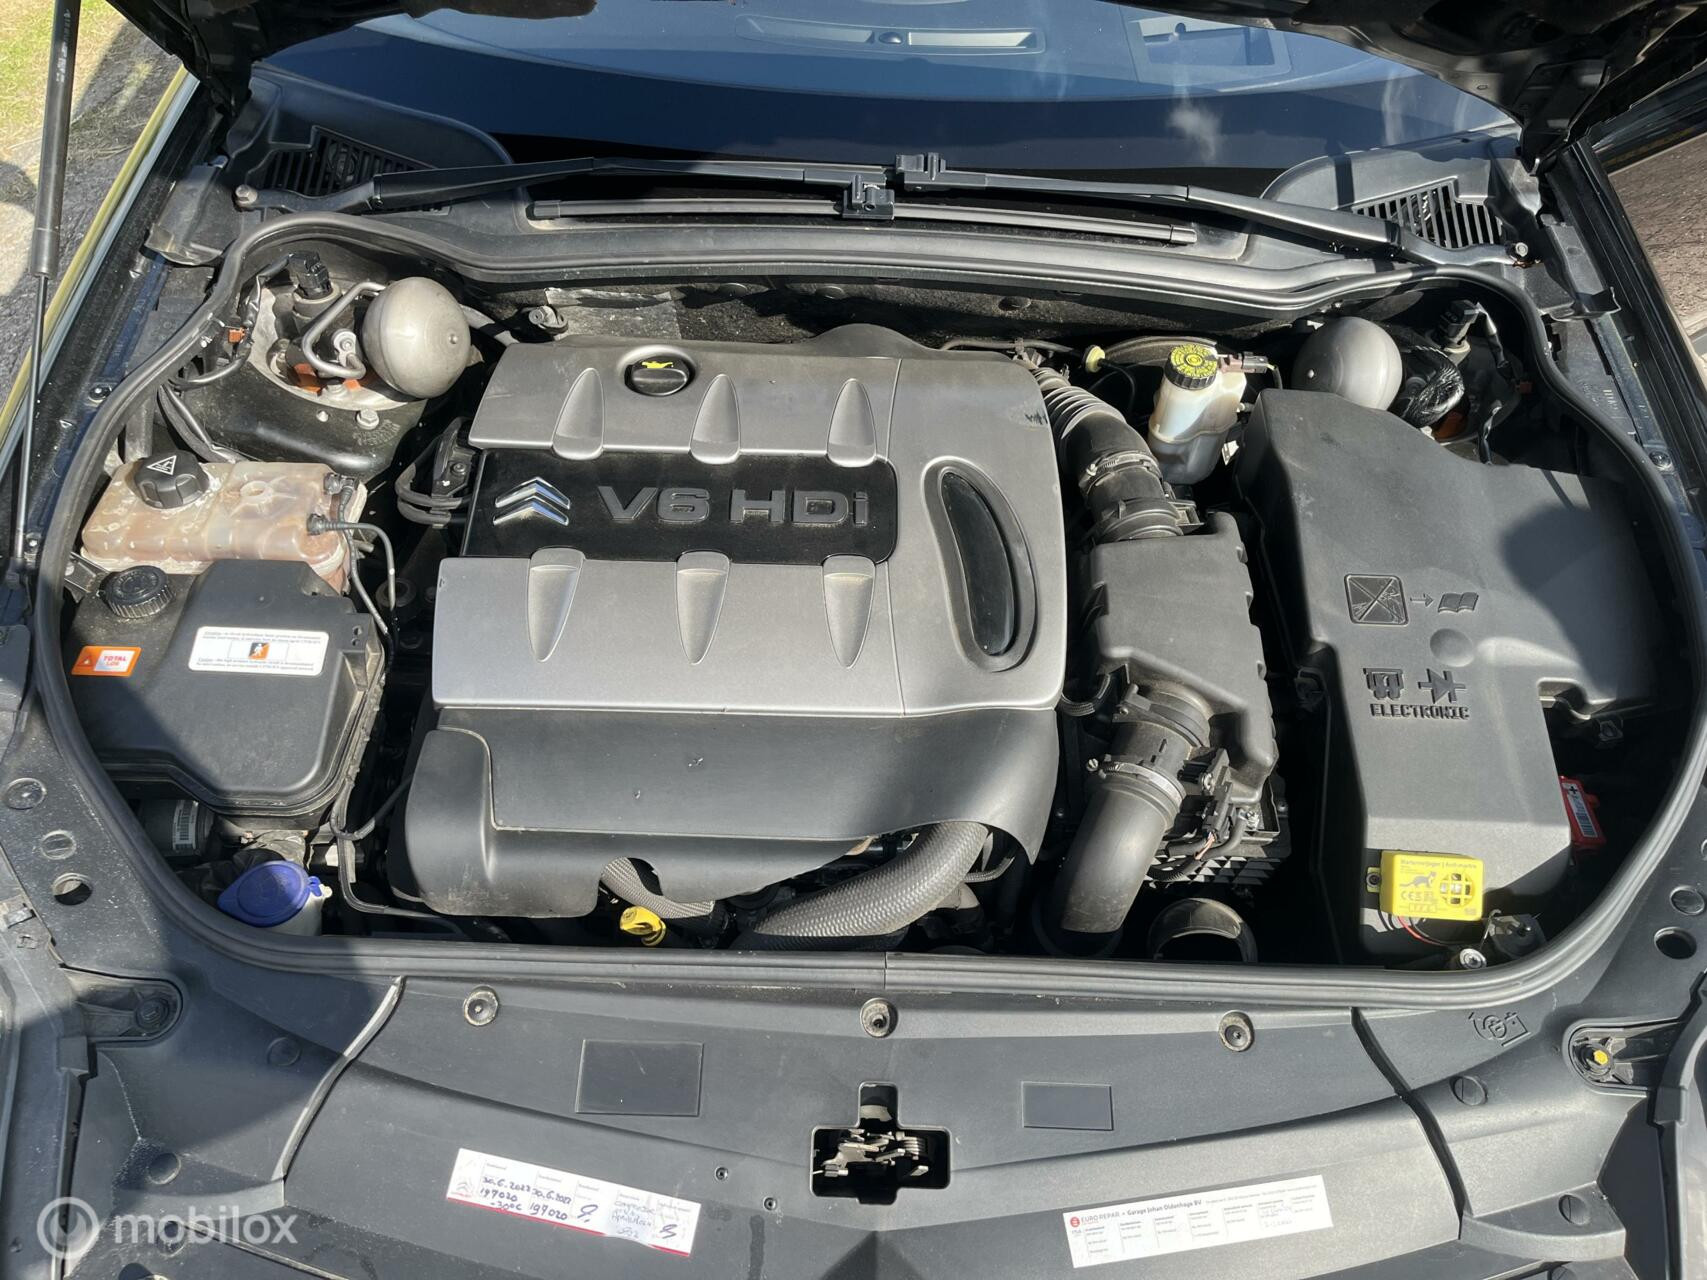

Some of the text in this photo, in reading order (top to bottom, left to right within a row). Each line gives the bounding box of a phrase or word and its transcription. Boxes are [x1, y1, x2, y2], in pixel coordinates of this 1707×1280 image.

[597, 486, 869, 526] V6 HDi
[103, 654, 126, 662] TOTAL
[1369, 703, 1470, 720] ELECTRONIC
[1127, 1204, 1147, 1216] Garage
[1146, 1201, 1163, 1214] Johan
